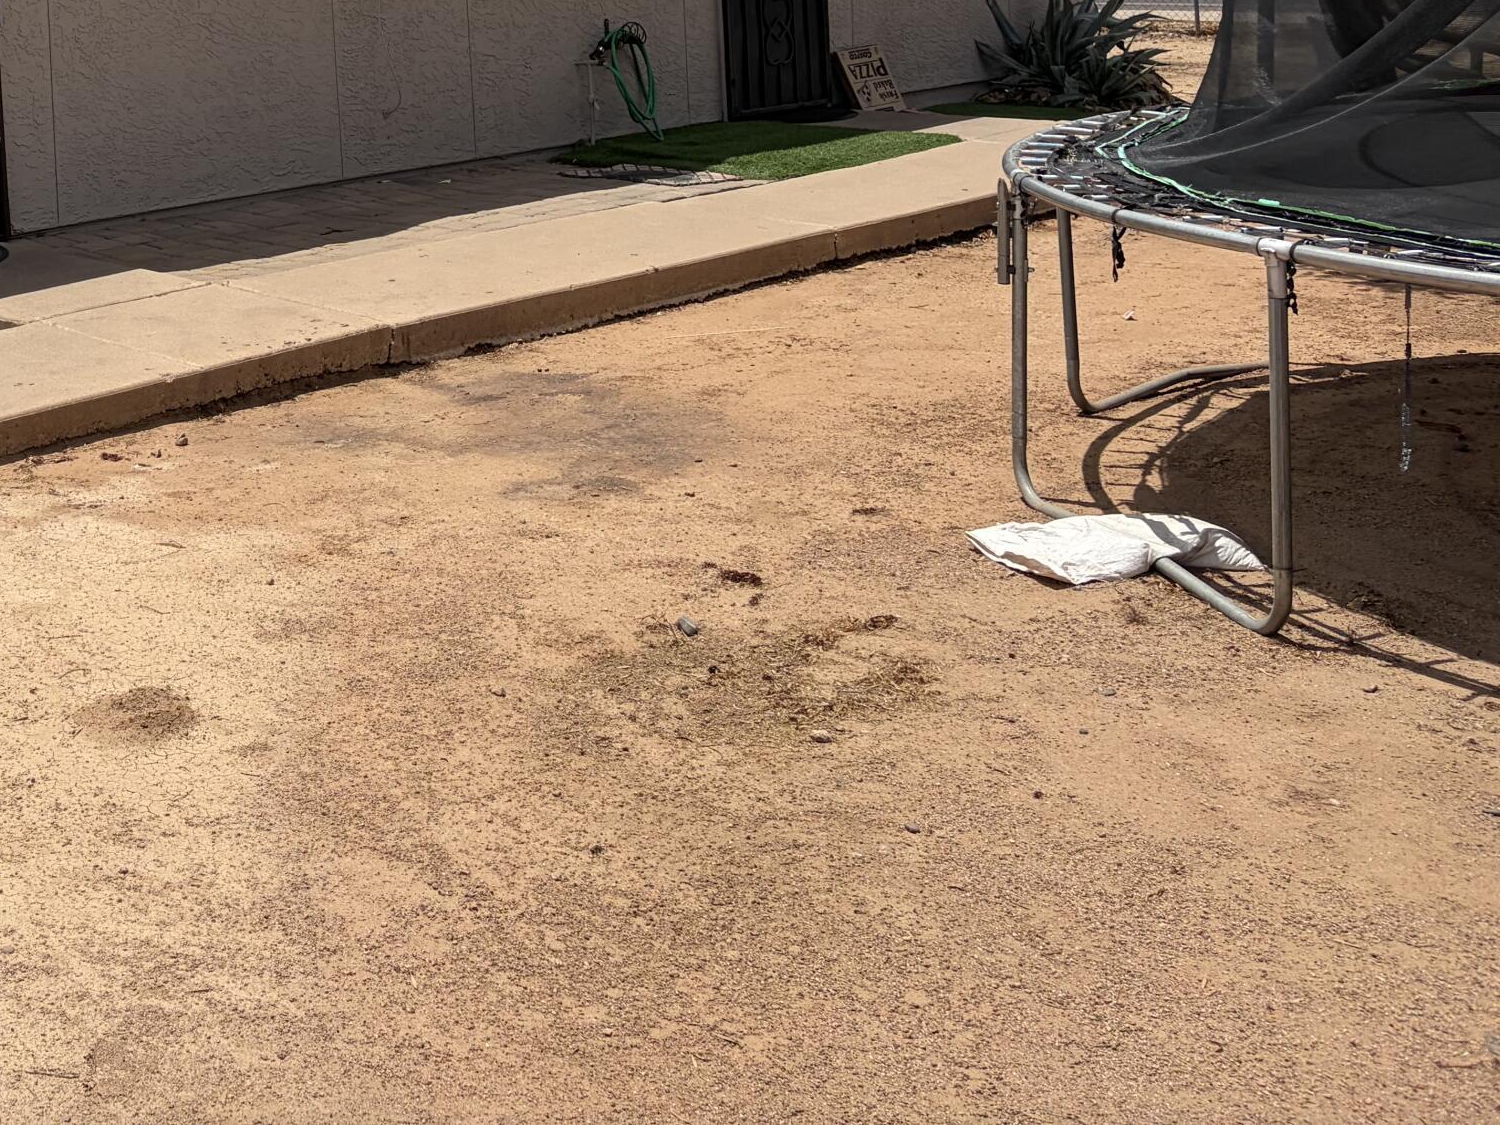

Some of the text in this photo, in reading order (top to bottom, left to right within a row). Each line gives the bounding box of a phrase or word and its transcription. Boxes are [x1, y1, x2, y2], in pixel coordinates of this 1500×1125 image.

[848, 57, 889, 80] PIZZA
[873, 79, 895, 92] Baked
[879, 90, 899, 101] Fresh
